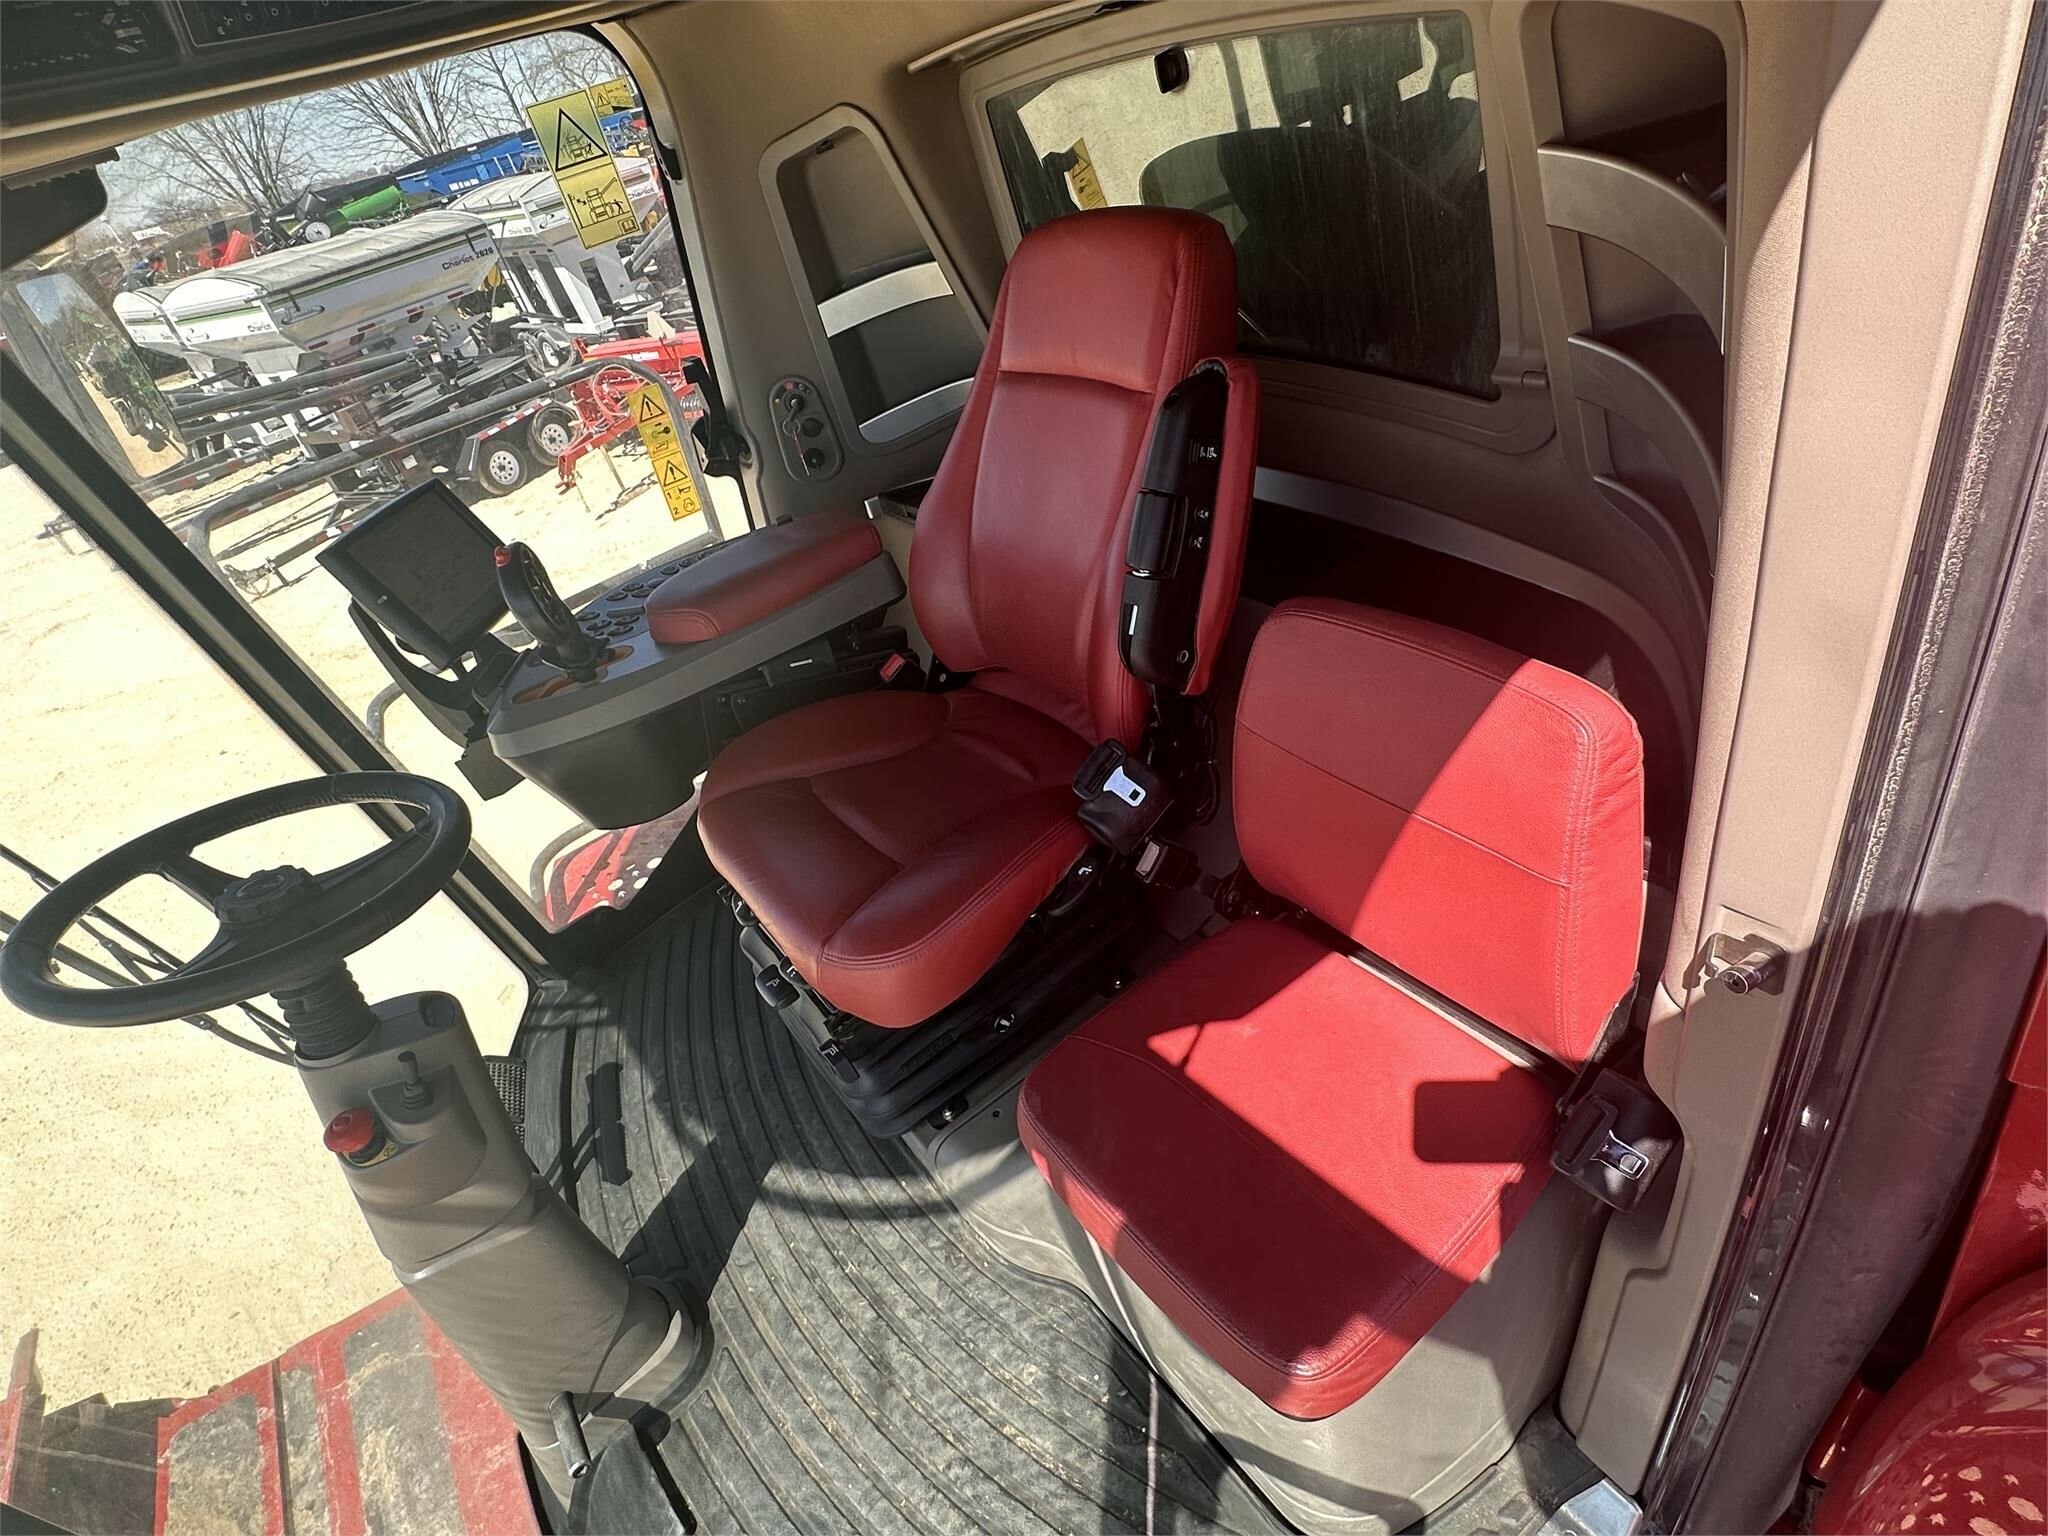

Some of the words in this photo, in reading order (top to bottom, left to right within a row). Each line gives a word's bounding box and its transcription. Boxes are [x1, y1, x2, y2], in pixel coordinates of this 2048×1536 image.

[442, 254, 474, 270] Chariot
[667, 492, 672, 500] 1
[673, 507, 679, 515] 2
